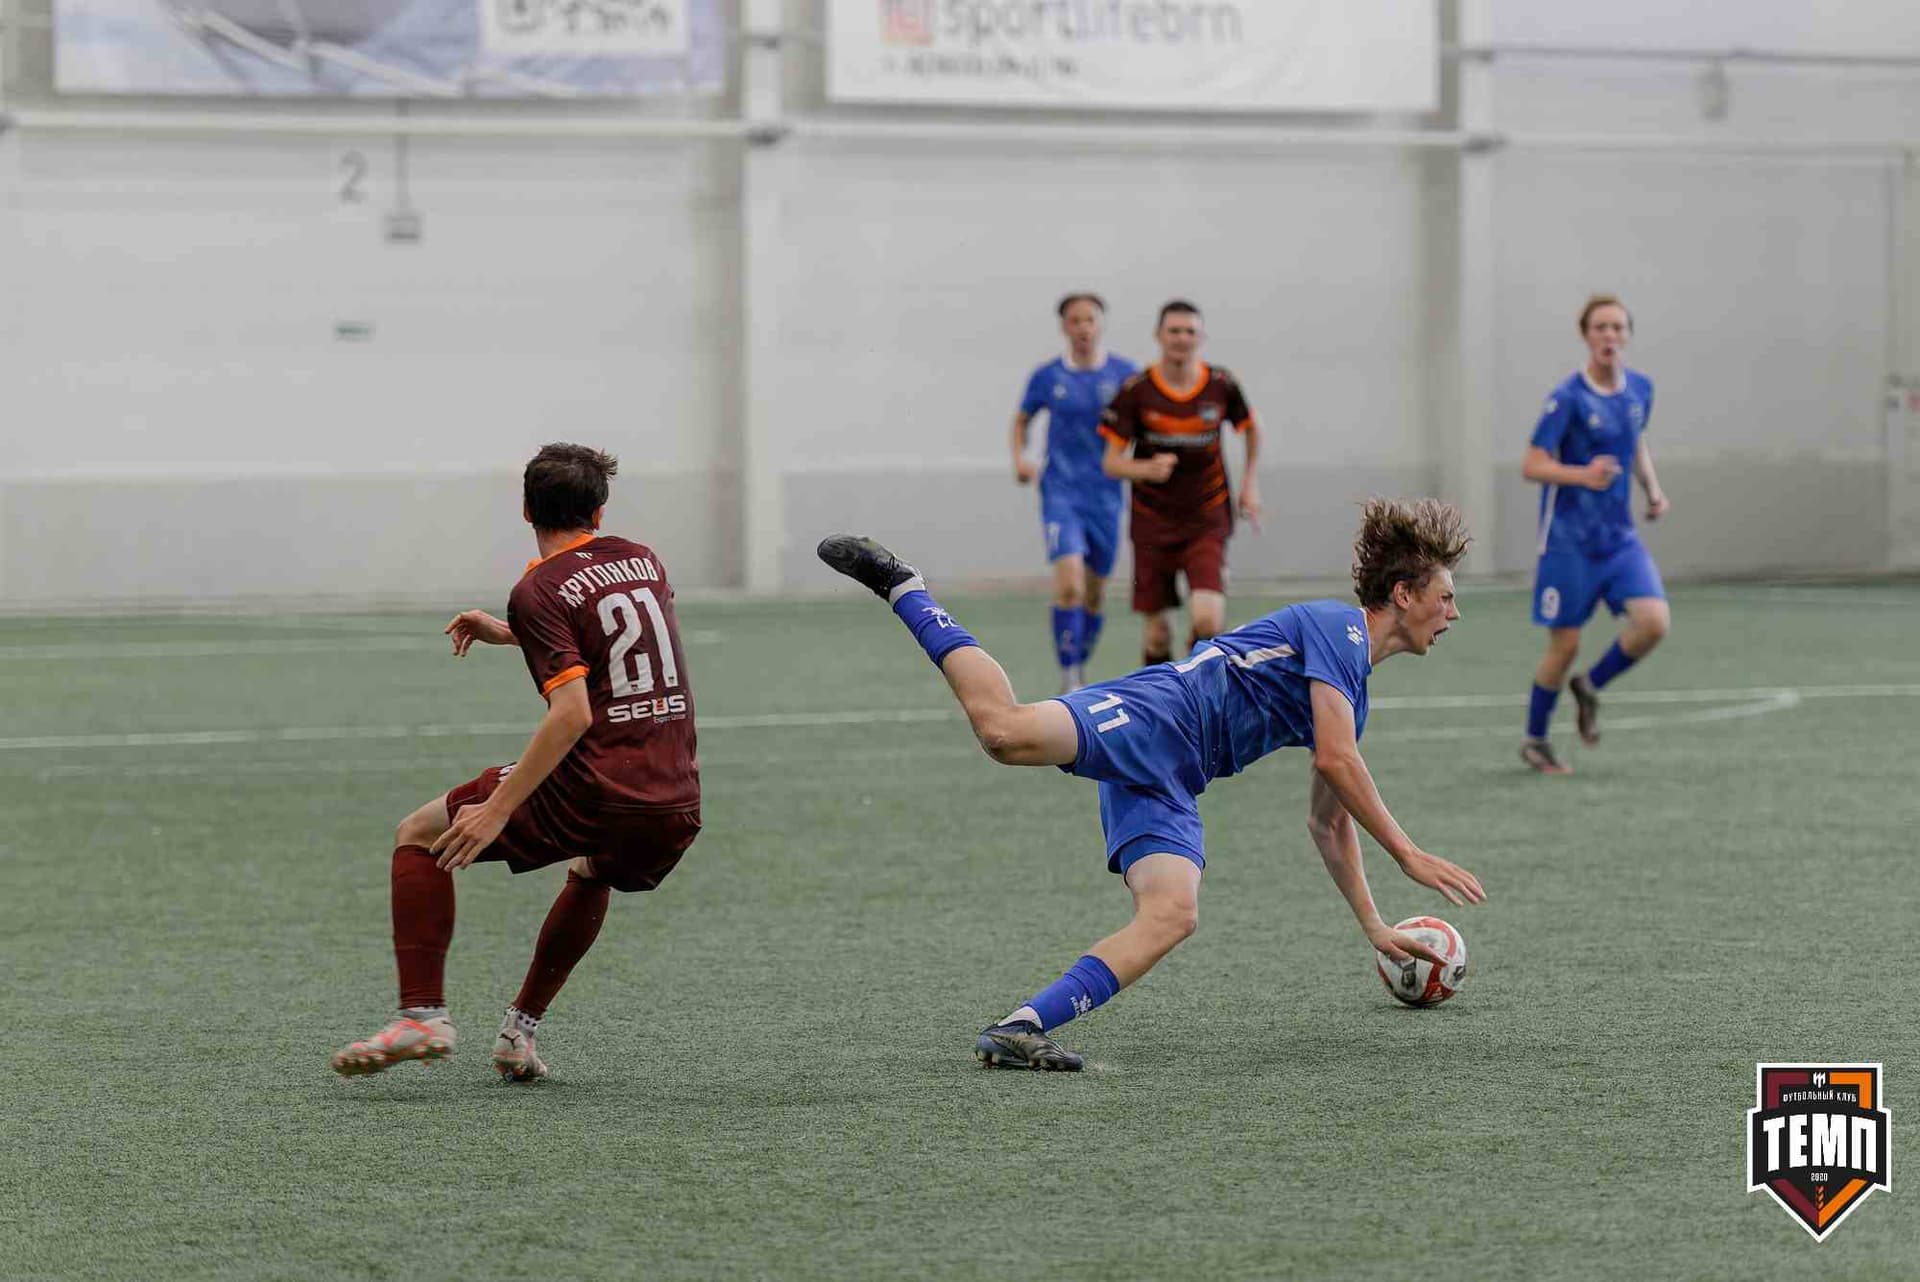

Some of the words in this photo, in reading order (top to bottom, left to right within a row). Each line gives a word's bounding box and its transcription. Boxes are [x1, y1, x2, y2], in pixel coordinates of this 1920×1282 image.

[340, 149, 369, 204] 2
[557, 557, 660, 608] КРУГЛЯКОВ
[597, 587, 678, 699] 21
[607, 694, 686, 723] SEUS
[1088, 693, 1130, 733] 11
